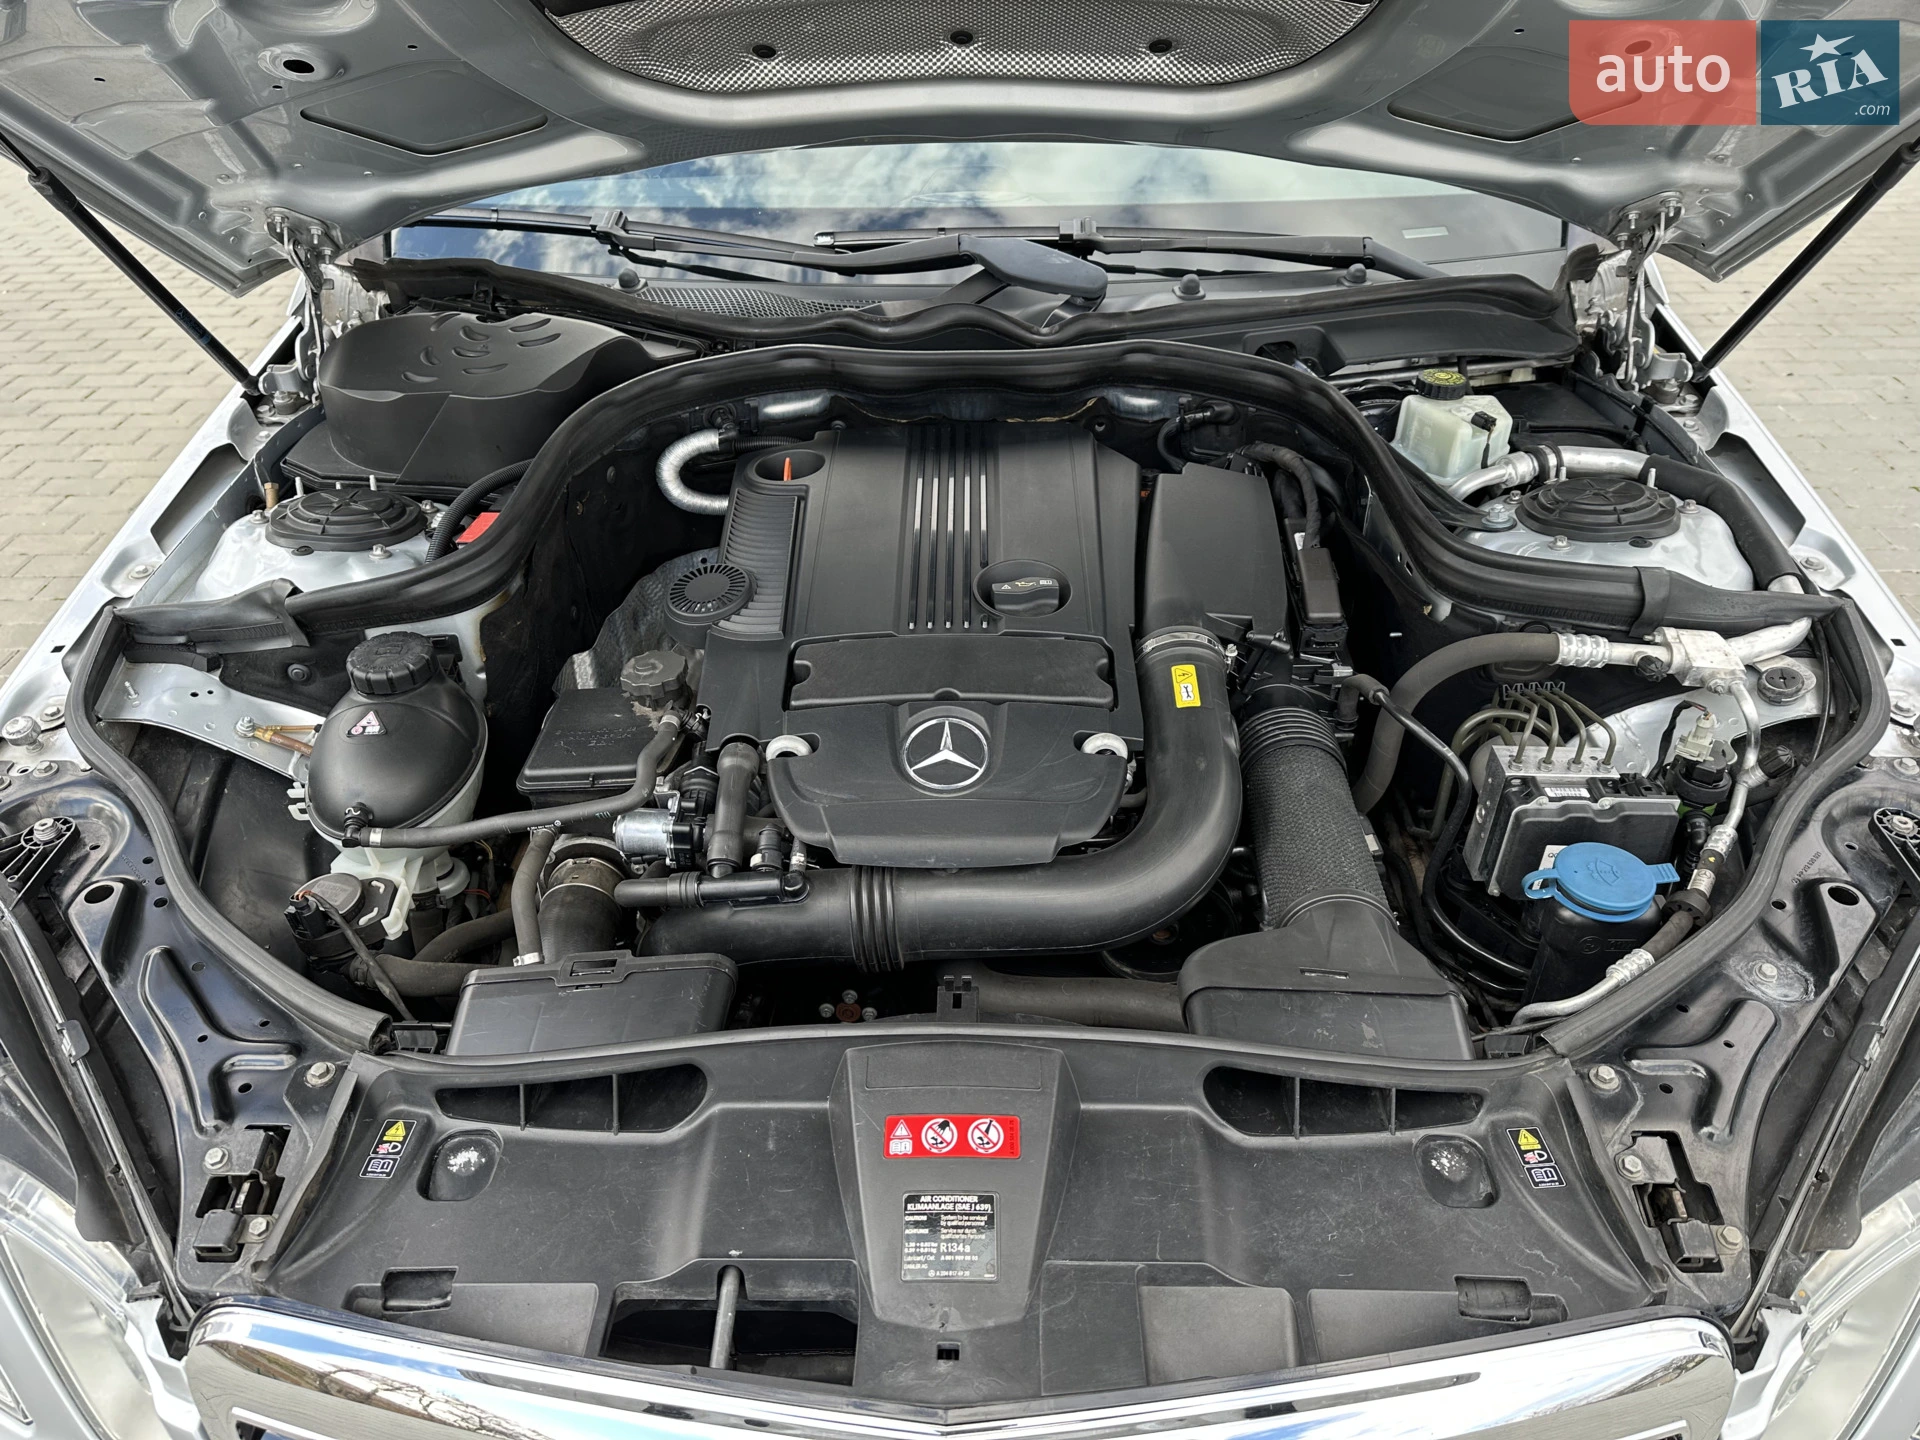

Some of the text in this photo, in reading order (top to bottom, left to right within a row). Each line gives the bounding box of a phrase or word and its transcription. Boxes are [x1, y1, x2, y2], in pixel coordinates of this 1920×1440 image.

[955, 1203, 970, 1211] (SAE
[976, 1204, 991, 1212] 639)
[940, 1243, 970, 1252] R134a
